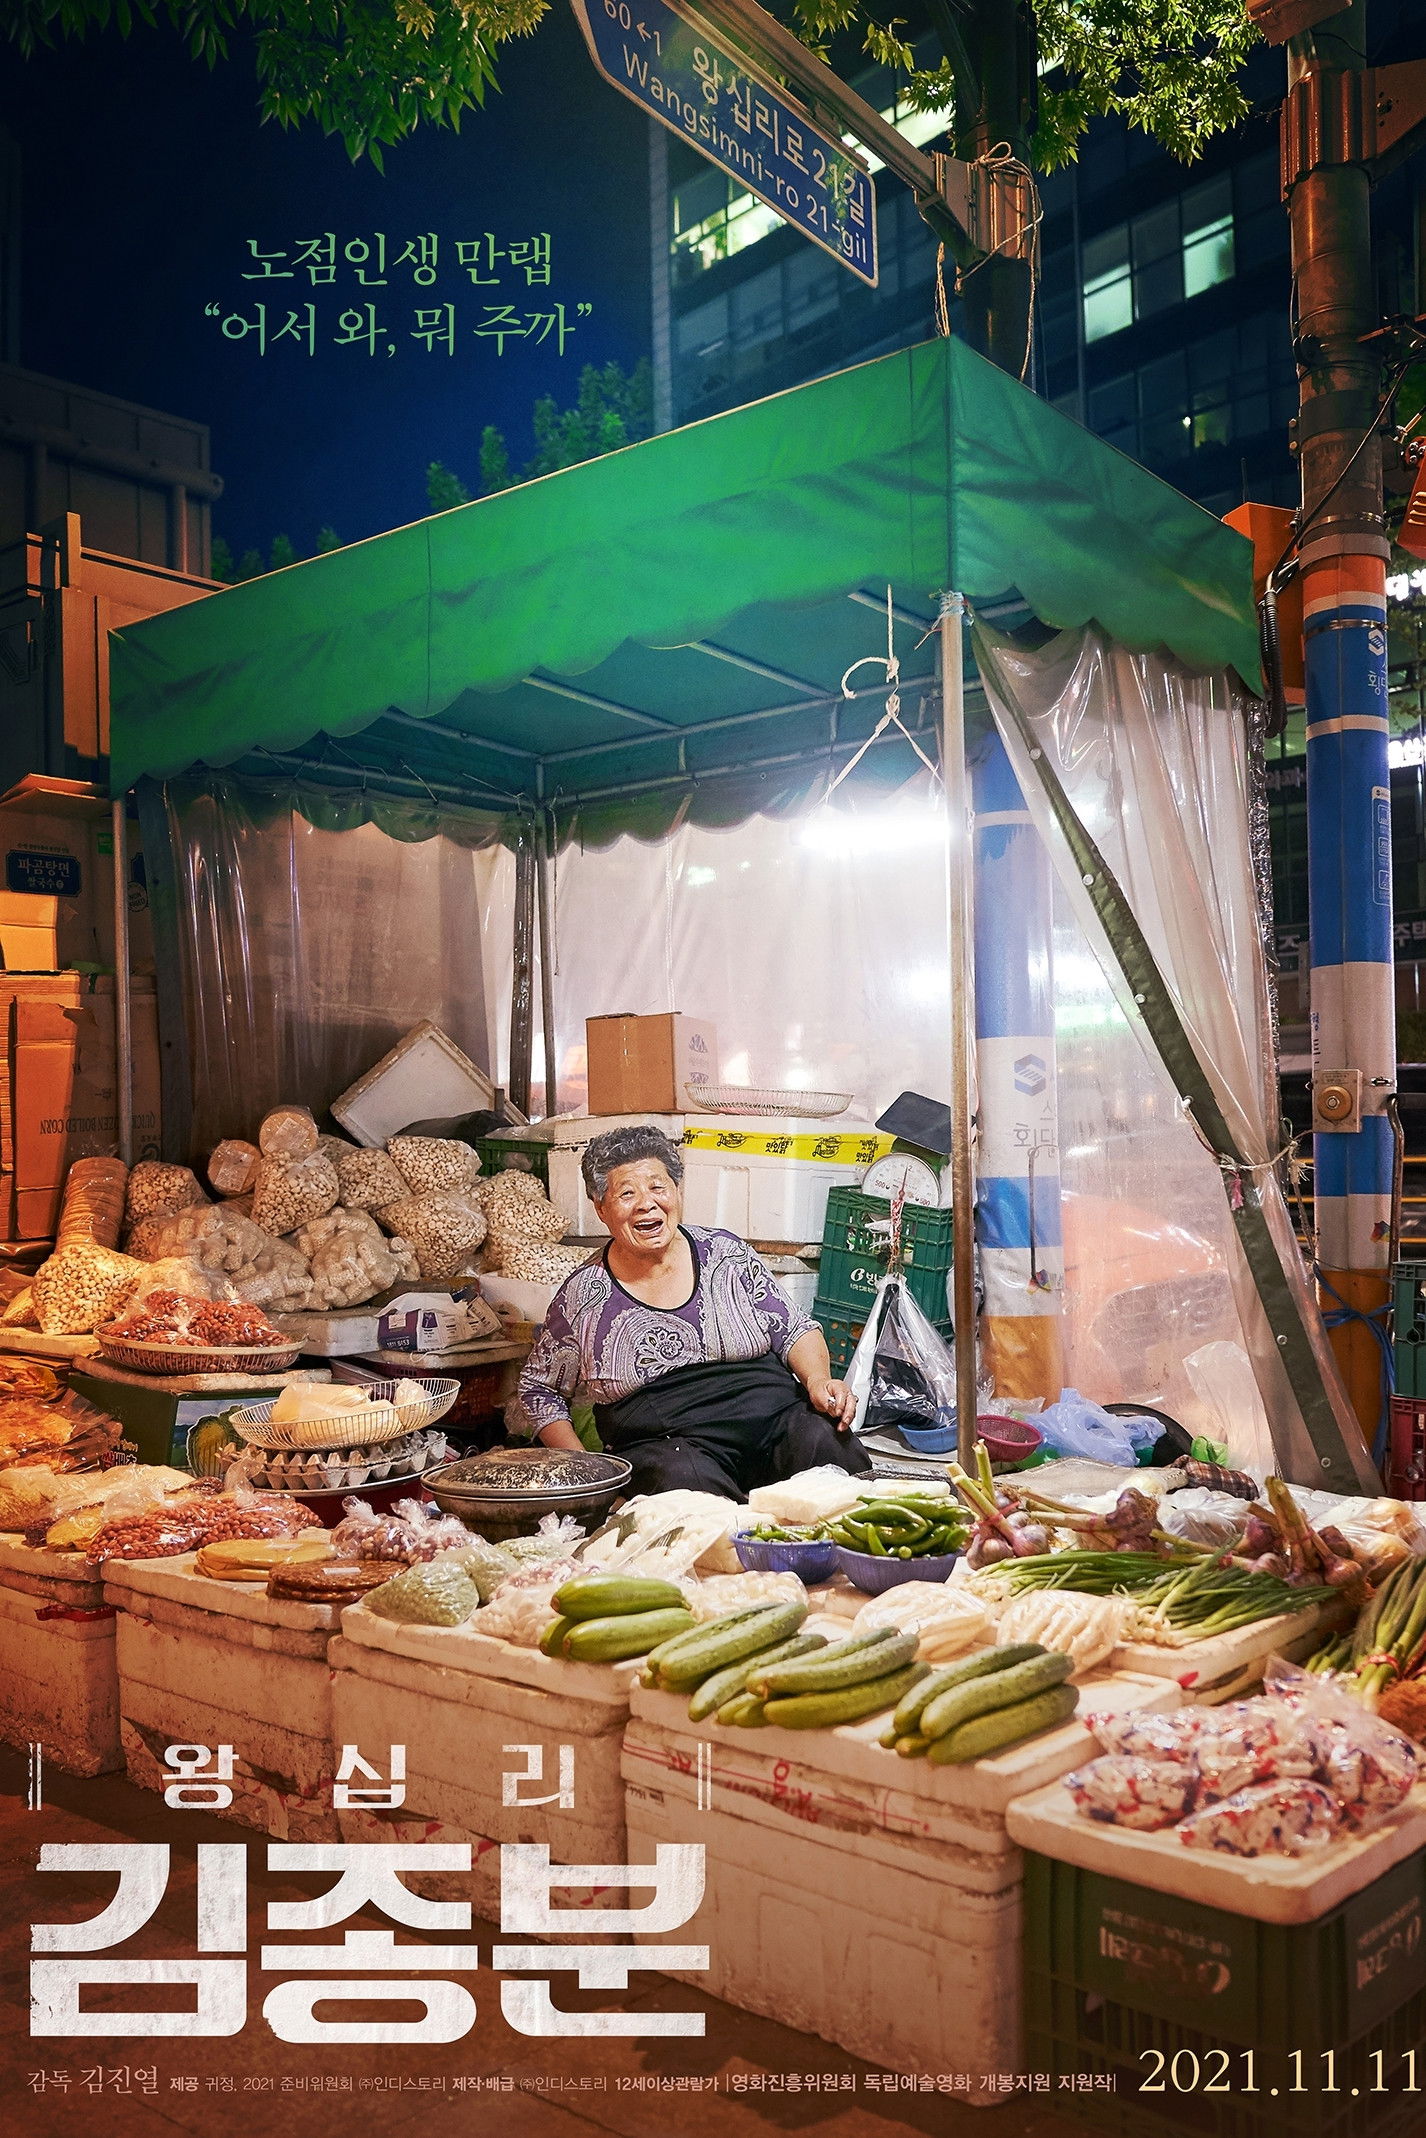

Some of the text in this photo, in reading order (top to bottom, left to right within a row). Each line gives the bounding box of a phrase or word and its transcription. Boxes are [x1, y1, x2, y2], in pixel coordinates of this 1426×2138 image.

[622, 44, 867, 264] Wangsimni-ro 21-gil
[691, 46, 866, 229] 왕십리로21길
[40, 1118, 65, 1135] CORN
